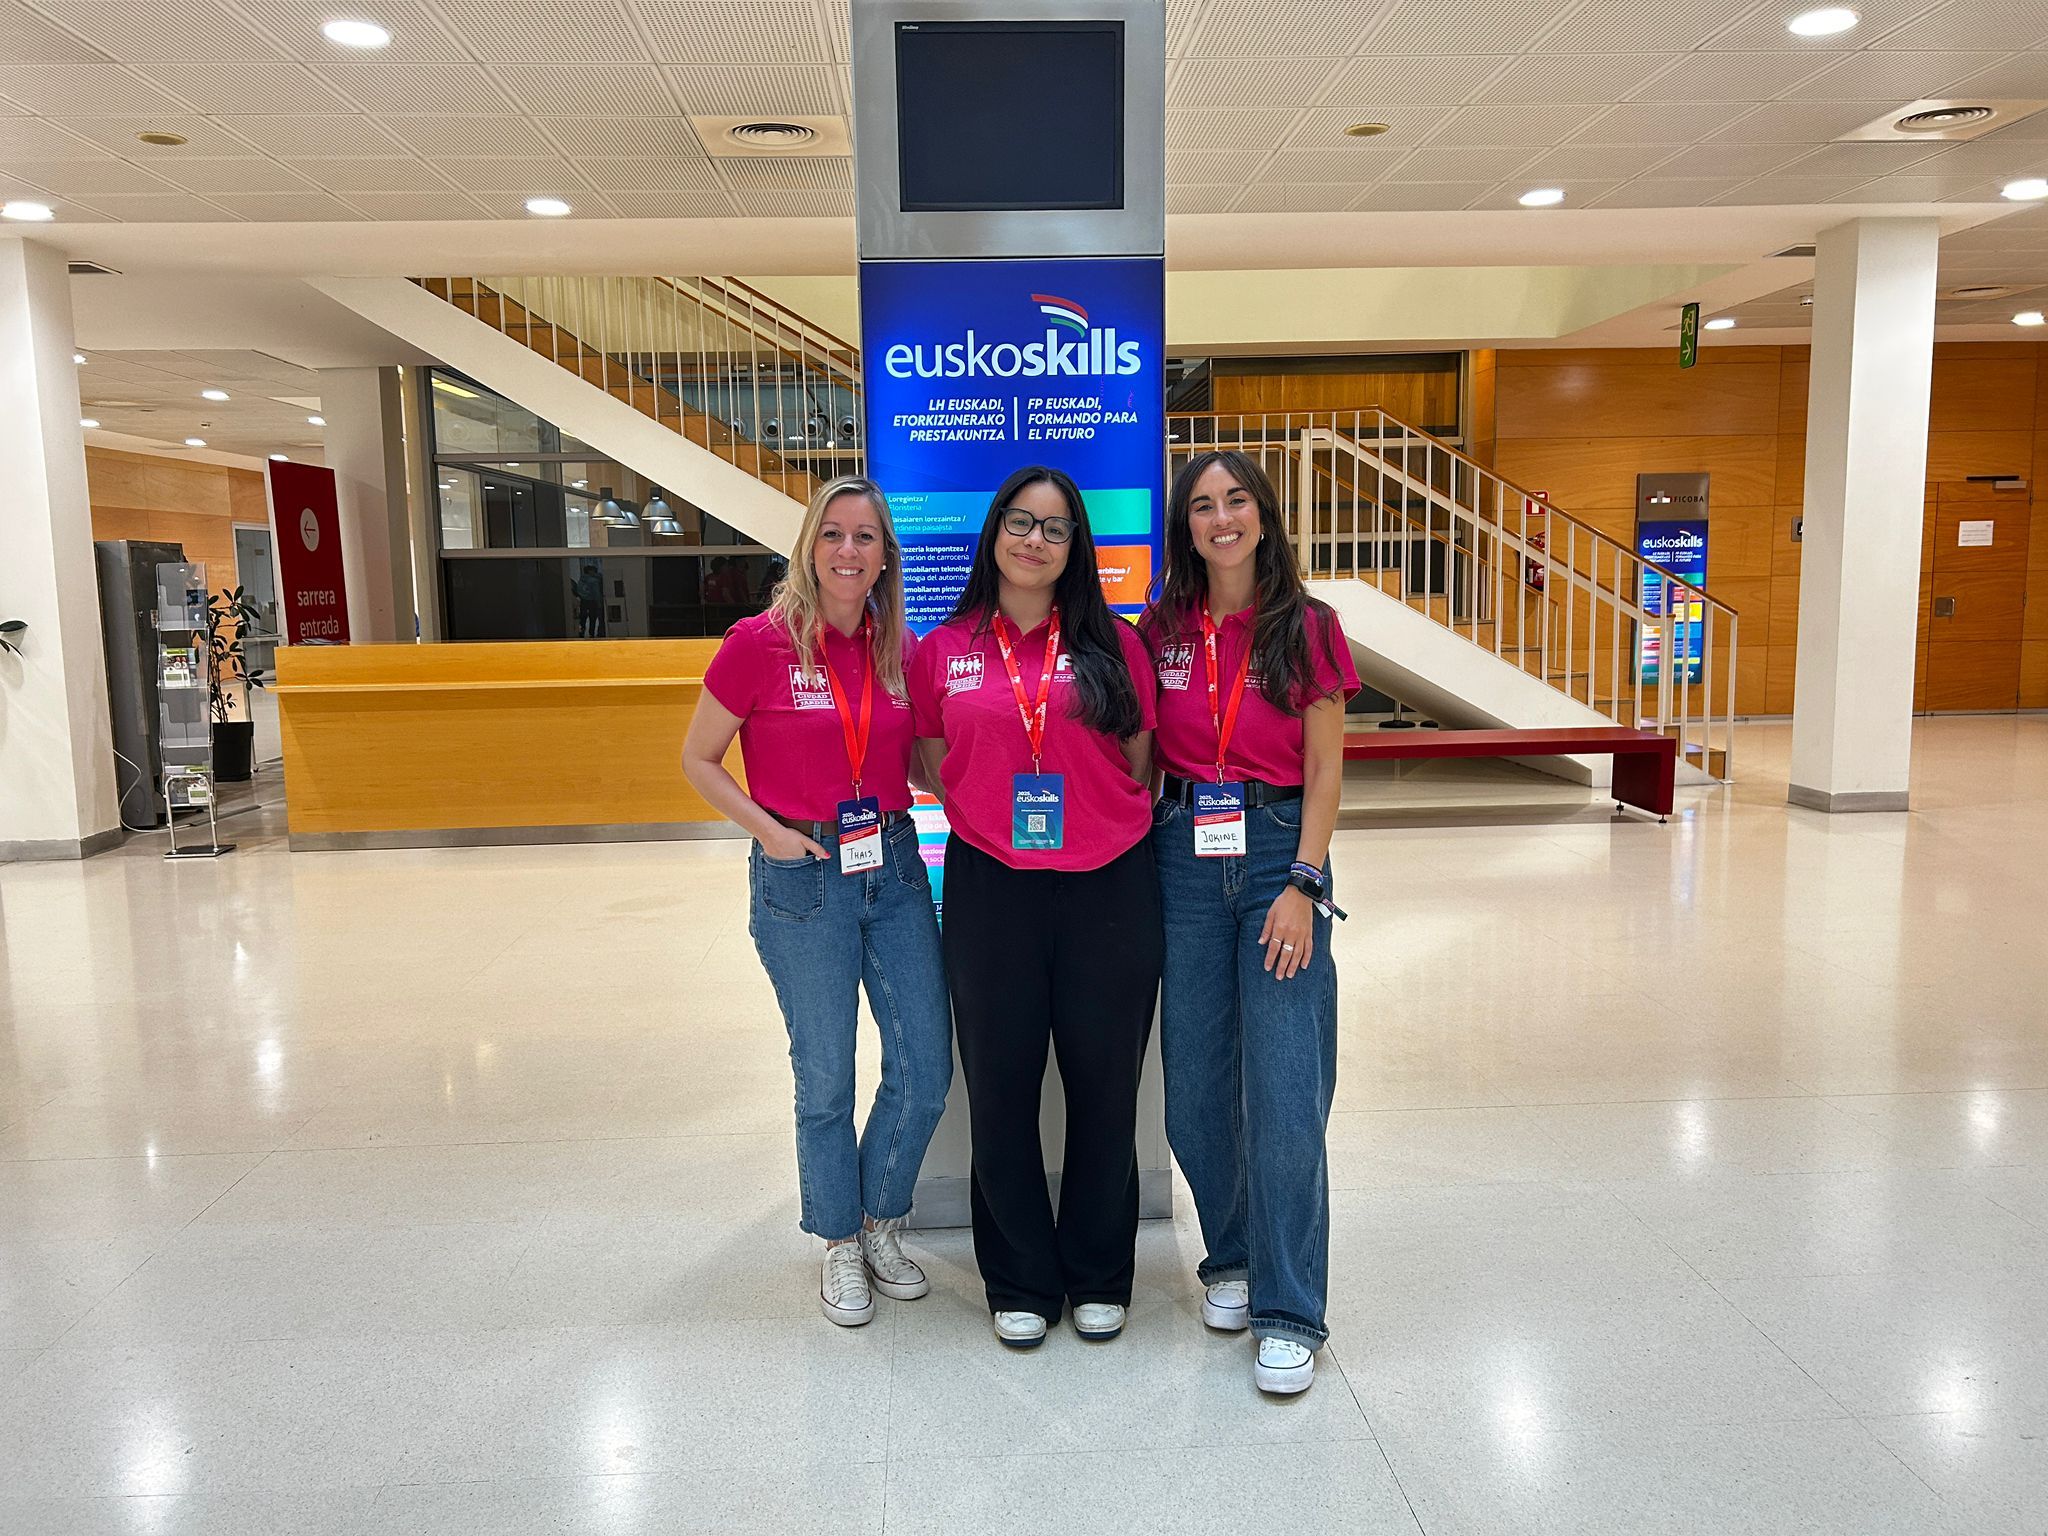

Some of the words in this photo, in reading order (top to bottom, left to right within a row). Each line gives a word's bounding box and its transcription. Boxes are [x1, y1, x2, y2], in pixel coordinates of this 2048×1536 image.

[885, 328, 1142, 378] euskoskills
[929, 399, 945, 411] LH
[949, 398, 1005, 412] EUSKADI,
[1028, 398, 1043, 410] FP
[1045, 396, 1102, 410] EUSKADI,
[893, 414, 1005, 427] ETORKIZUNERAKO
[1028, 412, 1101, 425] FORMANDO
[1104, 411, 1138, 424] PARA
[909, 429, 1005, 442] PRESTAKUNTZA
[1028, 428, 1043, 440] EL
[1045, 427, 1095, 440] FUTURO
[1674, 495, 1704, 503] FICOBA
[892, 515, 924, 523] aisaiaren
[1642, 535, 1704, 548] euskoskills
[940, 565, 973, 574] teknologi
[297, 590, 336, 607] sarrera
[300, 615, 340, 637] entrada
[1016, 793, 1060, 803] euskoskills
[1198, 797, 1241, 806] euskoskills
[842, 811, 877, 825] euskoskills
[1201, 831, 1239, 843] JOKINE
[847, 847, 873, 861] THAIS
